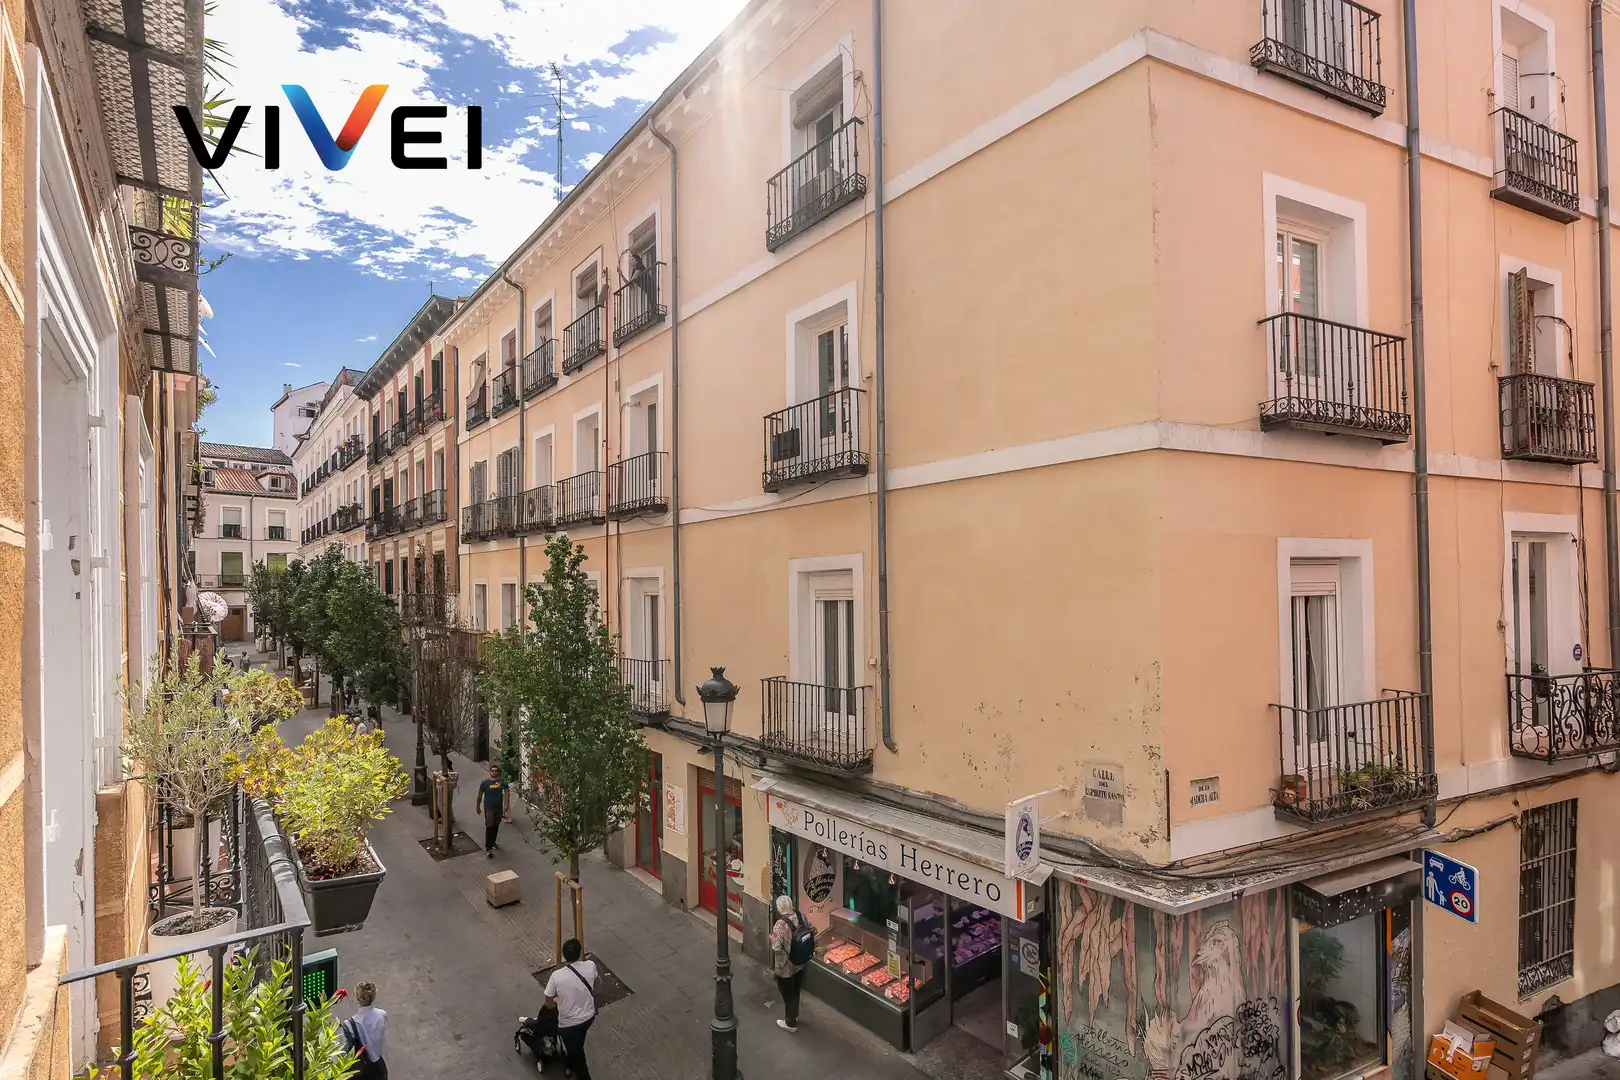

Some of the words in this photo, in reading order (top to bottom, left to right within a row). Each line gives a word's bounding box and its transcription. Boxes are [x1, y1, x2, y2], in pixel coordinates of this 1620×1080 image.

[1092, 768, 1115, 781] CALLE
[1098, 780, 1109, 788] DEL
[1197, 785, 1204, 793] DE
[803, 810, 888, 861] Pollerías
[900, 843, 1002, 902] Herrero
[1453, 896, 1468, 909] 20
